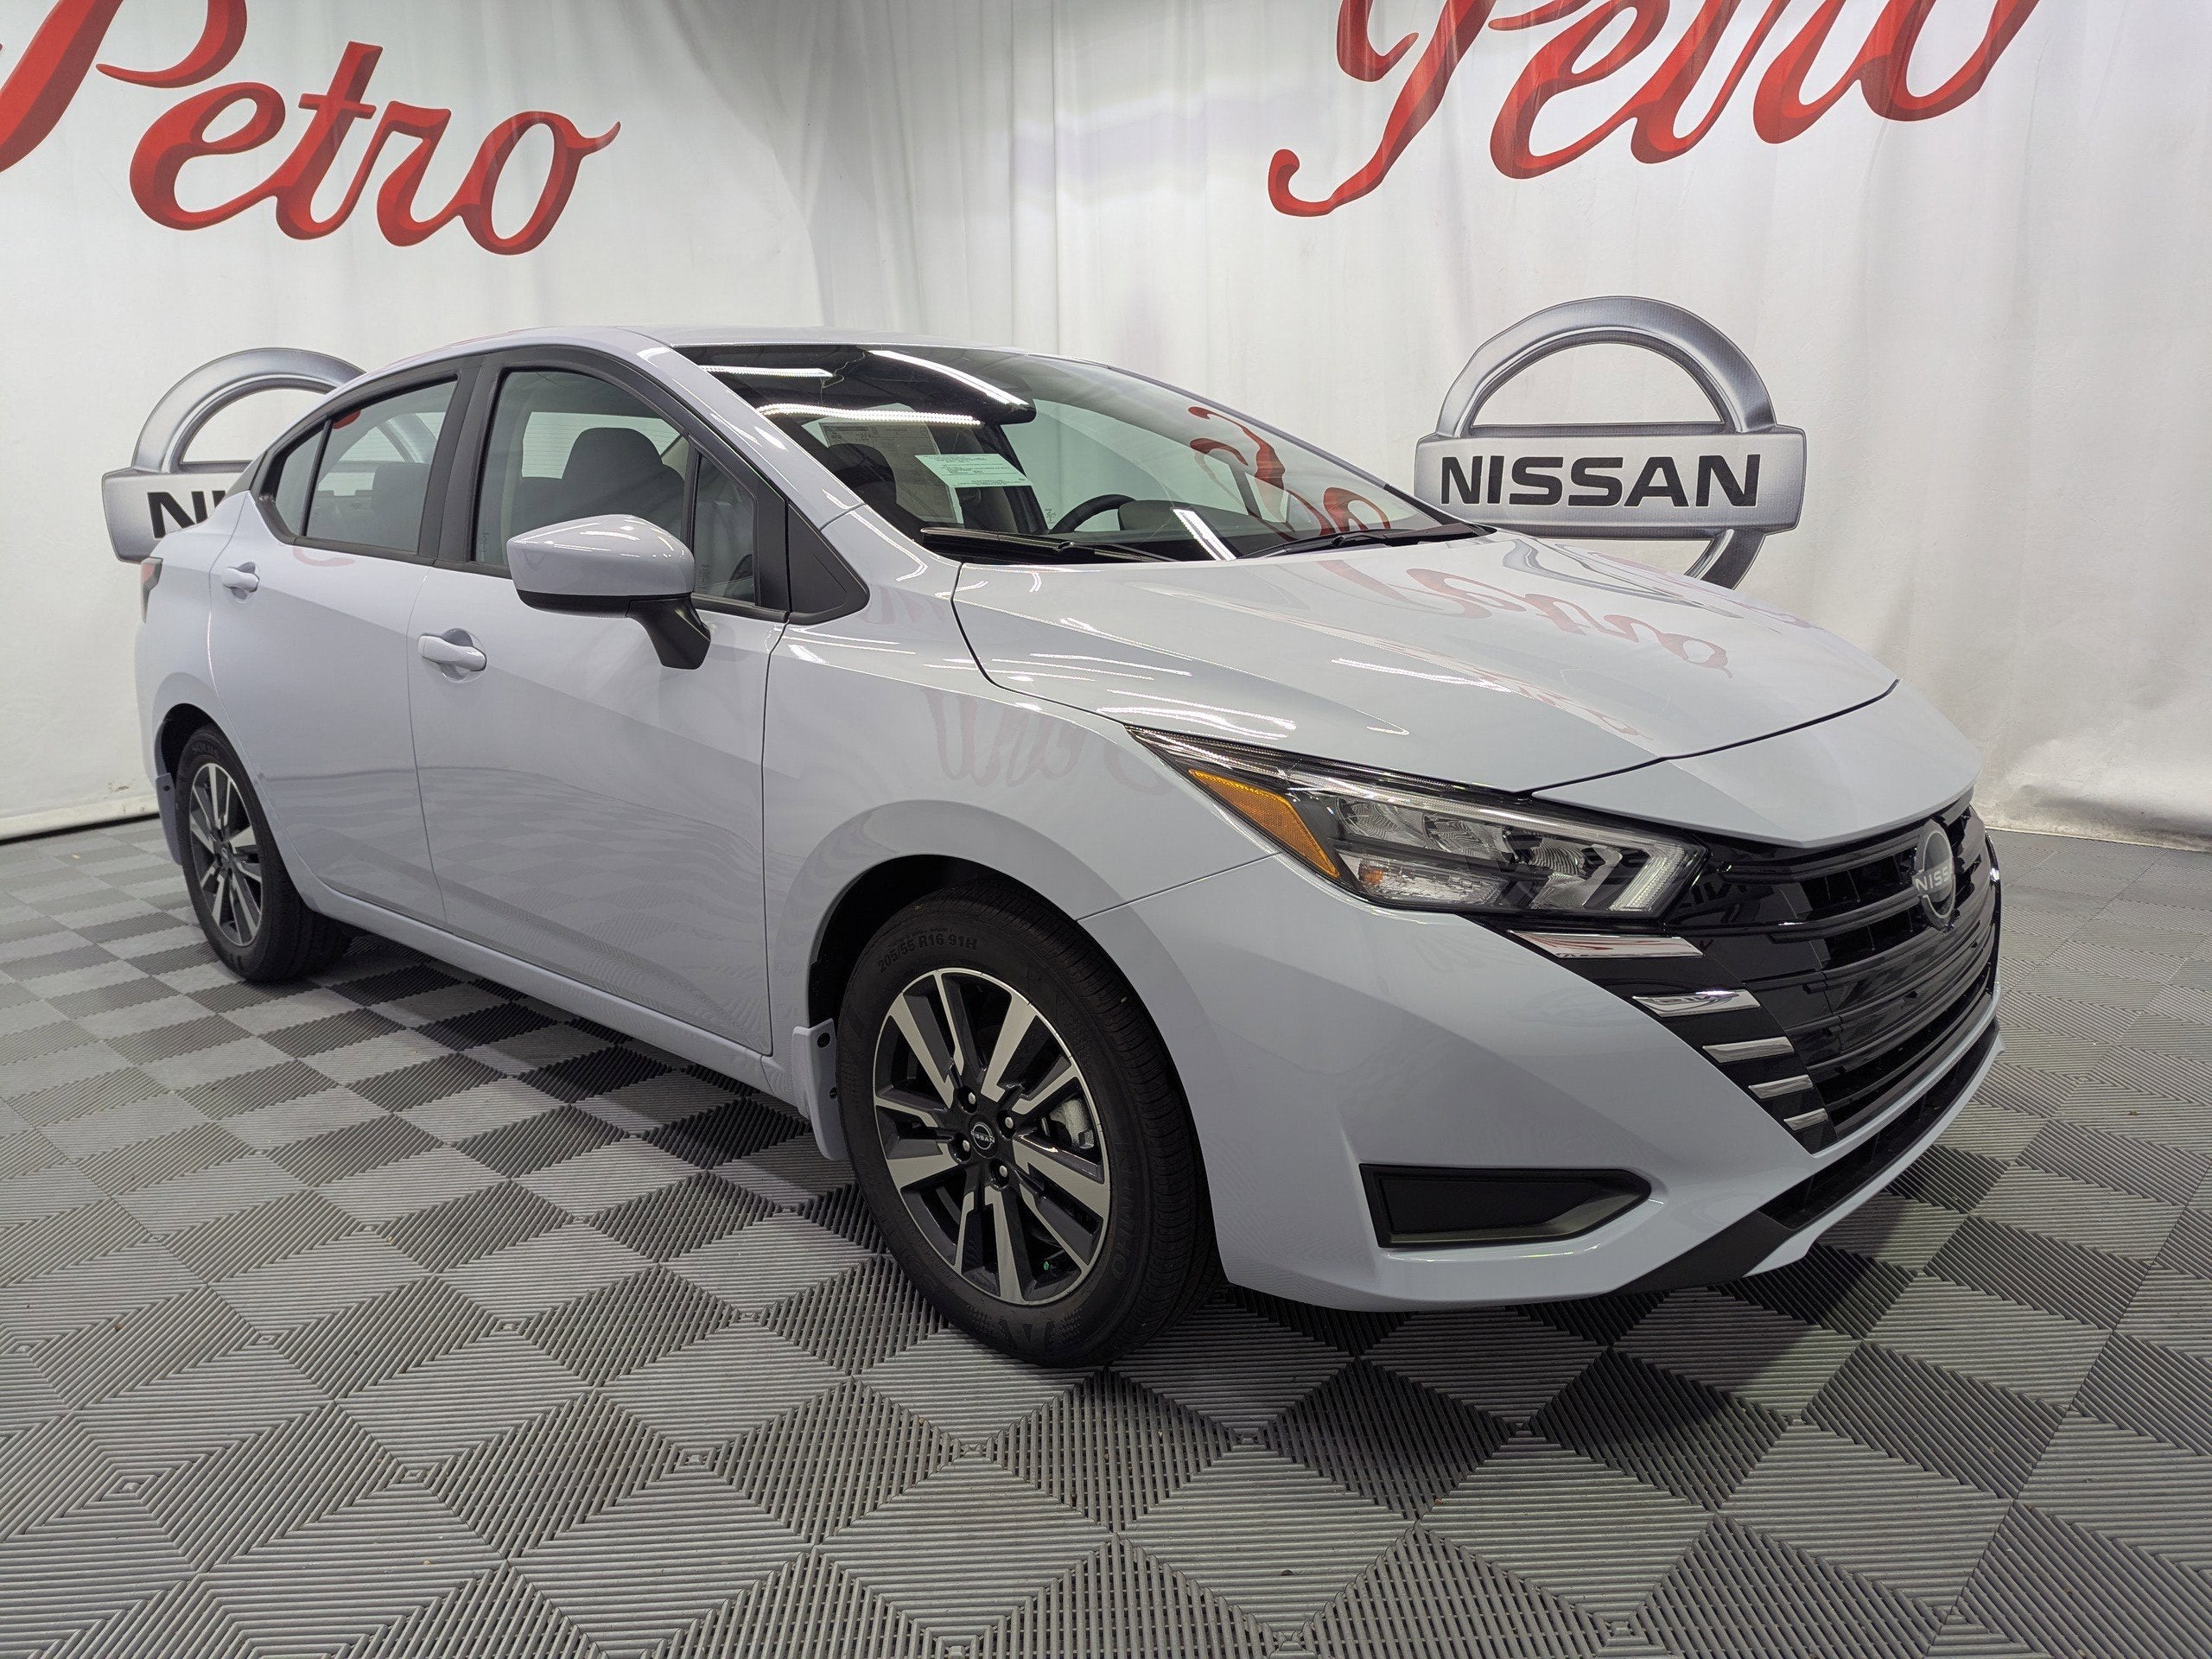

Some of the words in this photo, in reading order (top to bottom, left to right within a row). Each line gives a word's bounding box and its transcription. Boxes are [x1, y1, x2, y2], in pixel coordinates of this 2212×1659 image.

[1440, 454, 1761, 507] NISSAN
[877, 938, 917, 973] 205/55
[918, 933, 944, 949] R16
[948, 934, 978, 950] 91H
